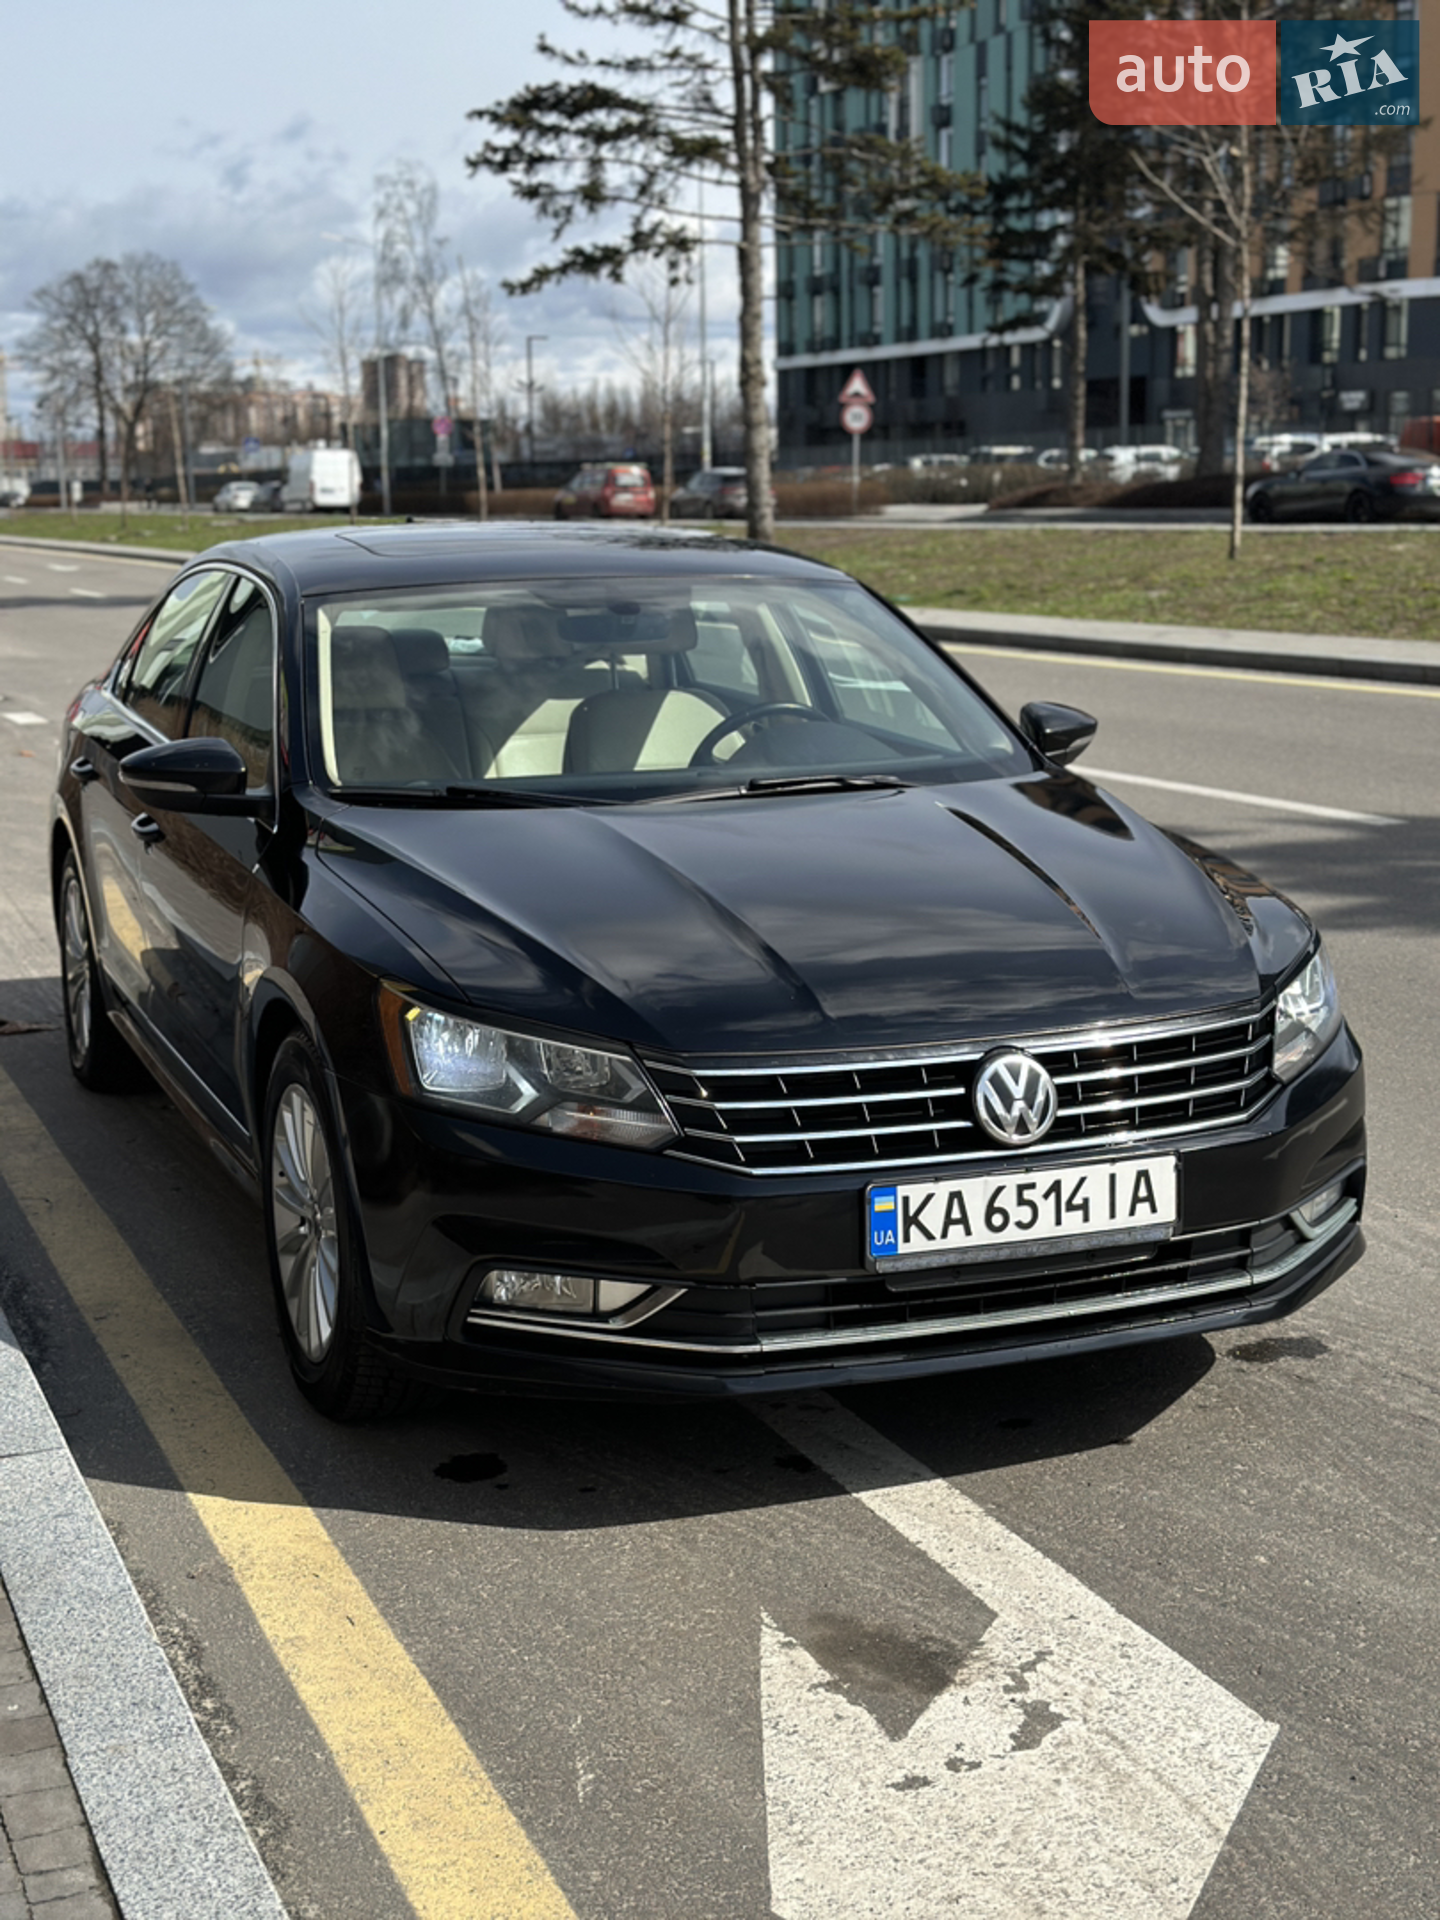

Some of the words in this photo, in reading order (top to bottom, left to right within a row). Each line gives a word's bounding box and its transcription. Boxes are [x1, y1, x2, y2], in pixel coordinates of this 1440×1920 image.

[902, 1189, 972, 1244] KA
[984, 1177, 1091, 1233] 6514
[1109, 1168, 1158, 1220] IA
[874, 1230, 896, 1246] UA
